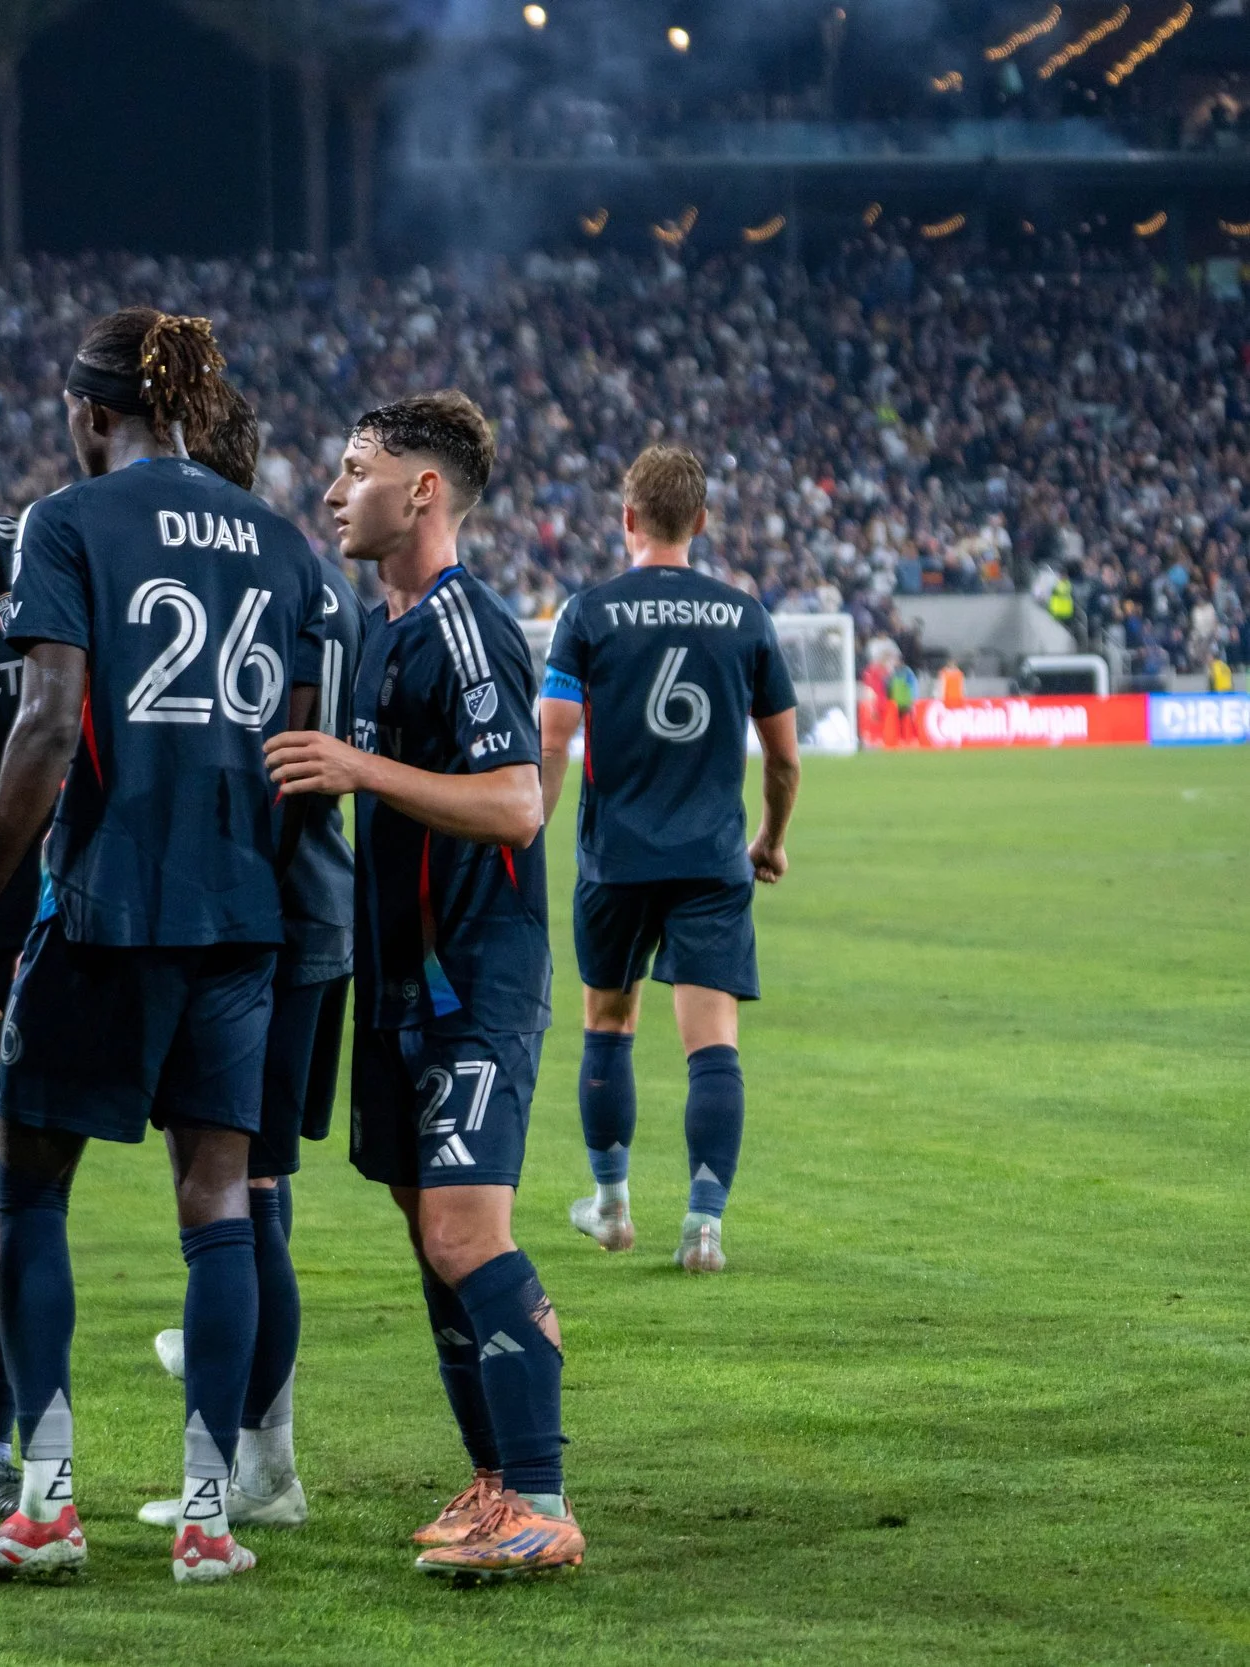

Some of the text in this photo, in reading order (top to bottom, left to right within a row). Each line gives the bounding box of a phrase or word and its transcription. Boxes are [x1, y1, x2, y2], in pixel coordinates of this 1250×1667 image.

[159, 510, 260, 556] DUAH
[605, 600, 743, 628] TVERSKOV
[127, 577, 284, 732] 26
[467, 688, 483, 702] MLS
[647, 646, 711, 742] 6
[1161, 700, 1250, 734] DIRE
[486, 731, 511, 752] tv
[417, 1060, 497, 1135] 27
